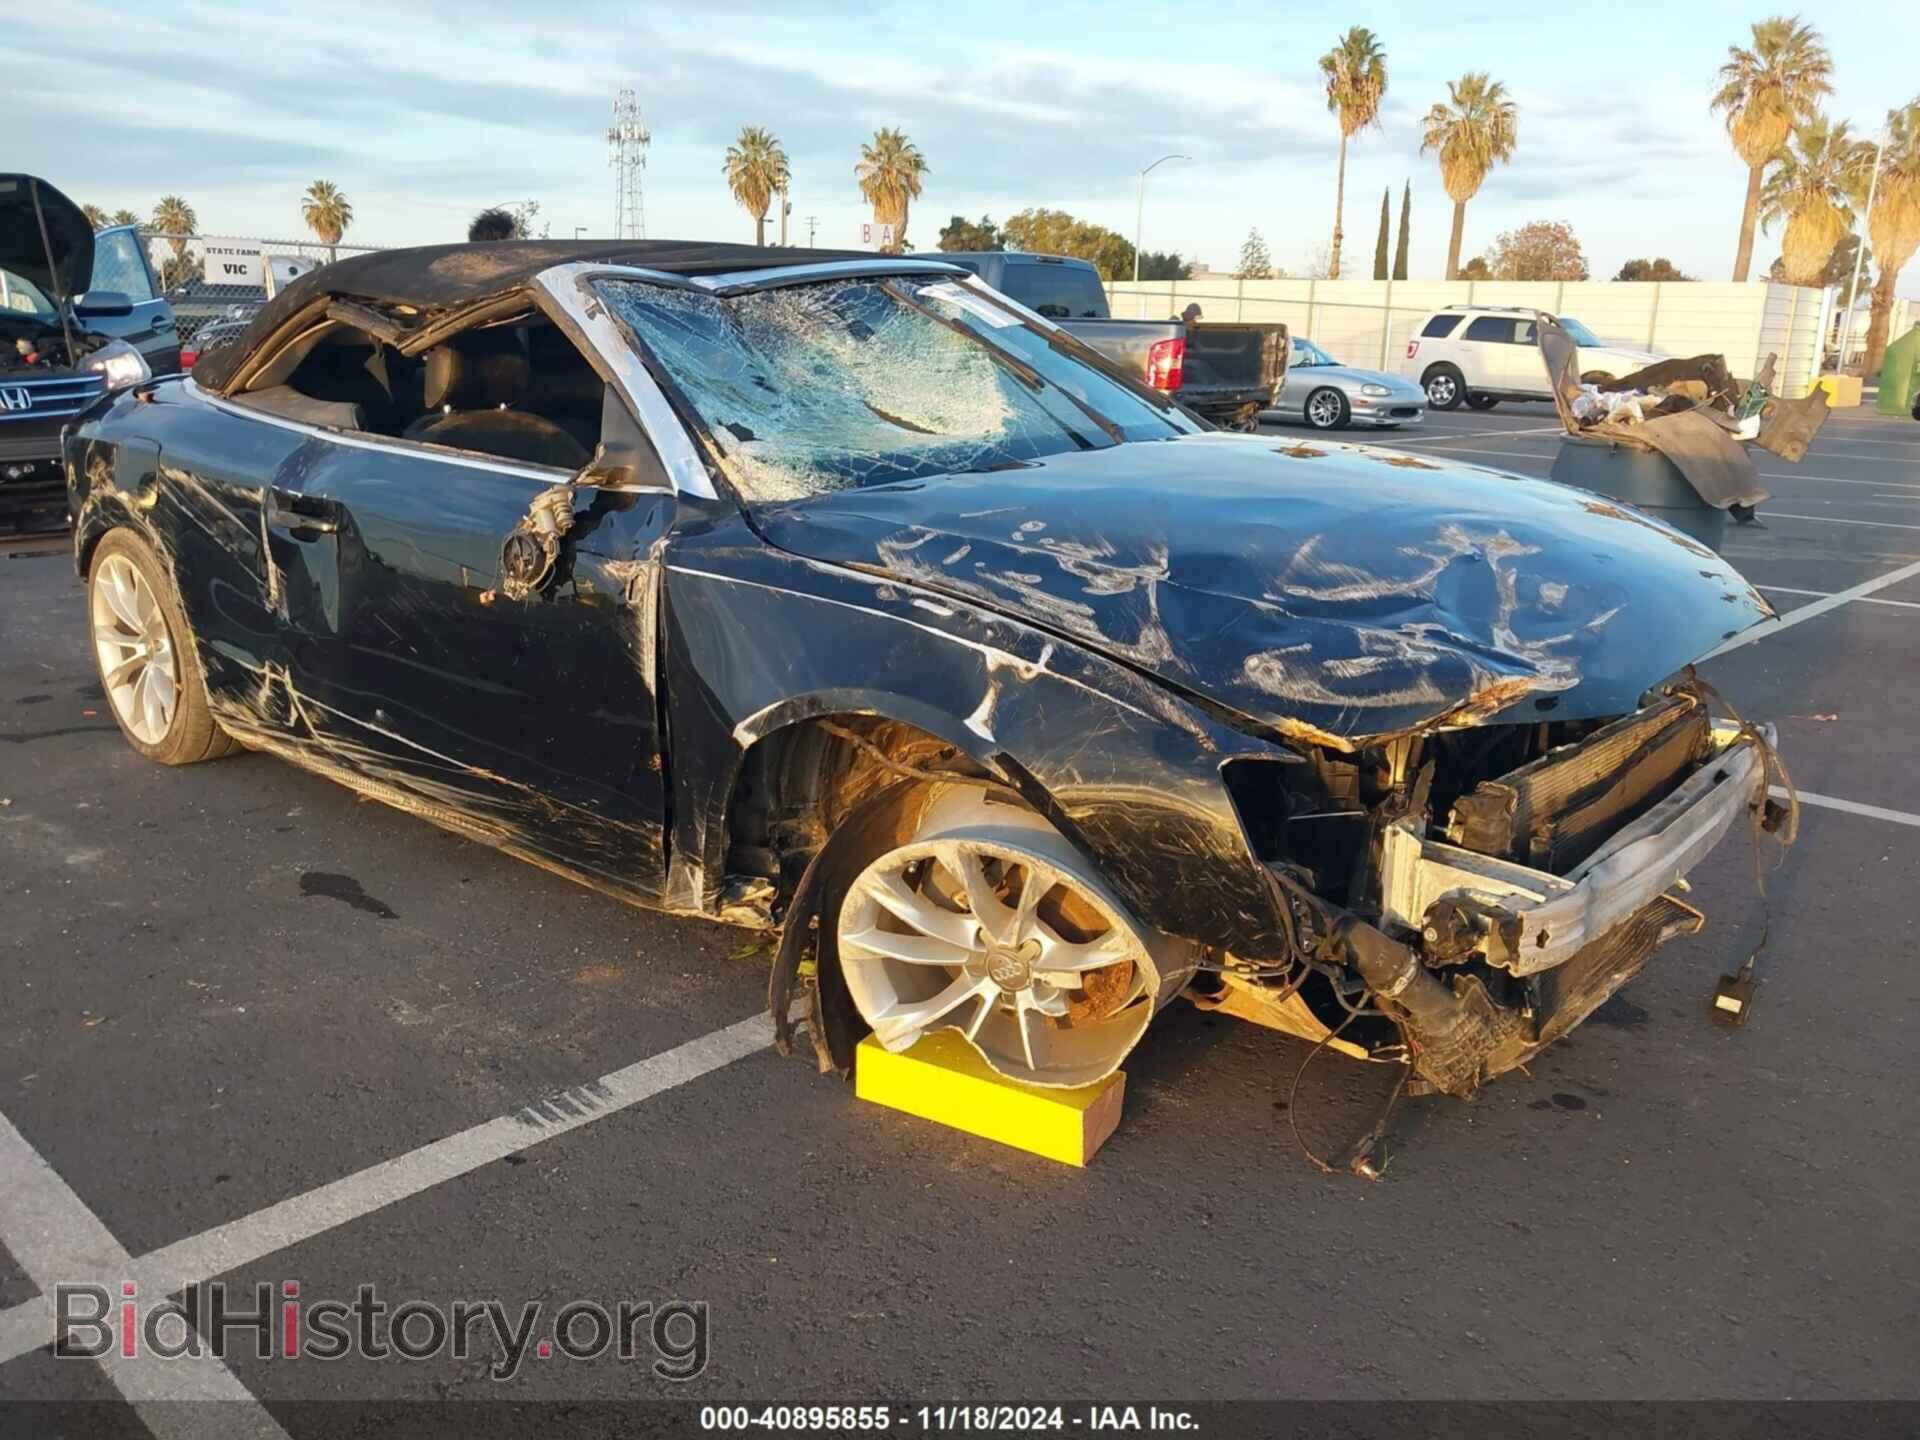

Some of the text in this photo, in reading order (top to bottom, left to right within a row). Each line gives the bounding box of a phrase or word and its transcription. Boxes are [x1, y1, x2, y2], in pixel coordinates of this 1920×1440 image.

[206, 247, 261, 256] STATE FARM
[223, 263, 247, 275] VIC
